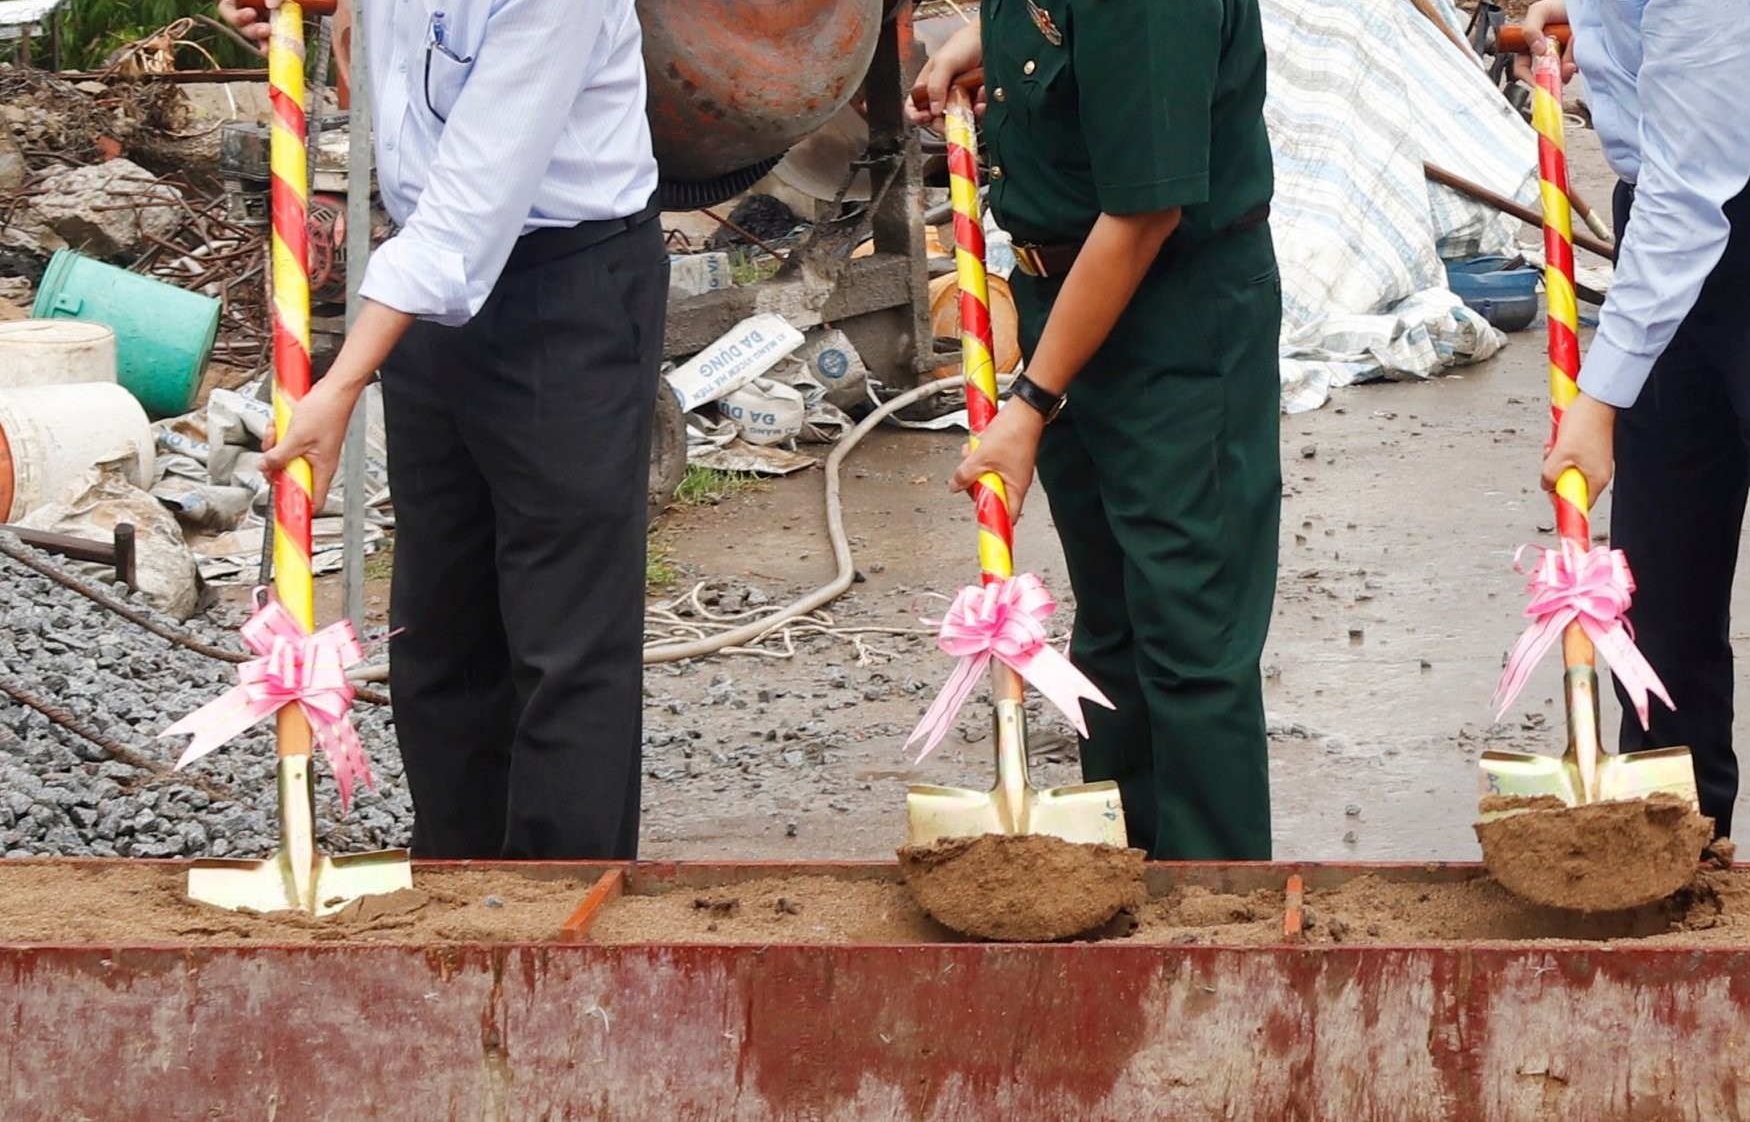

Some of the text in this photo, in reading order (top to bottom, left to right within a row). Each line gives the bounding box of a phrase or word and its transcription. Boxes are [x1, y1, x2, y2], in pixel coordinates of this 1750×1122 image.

[700, 330, 764, 378] ĐA DỤNG
[751, 412, 775, 425] ĐA
